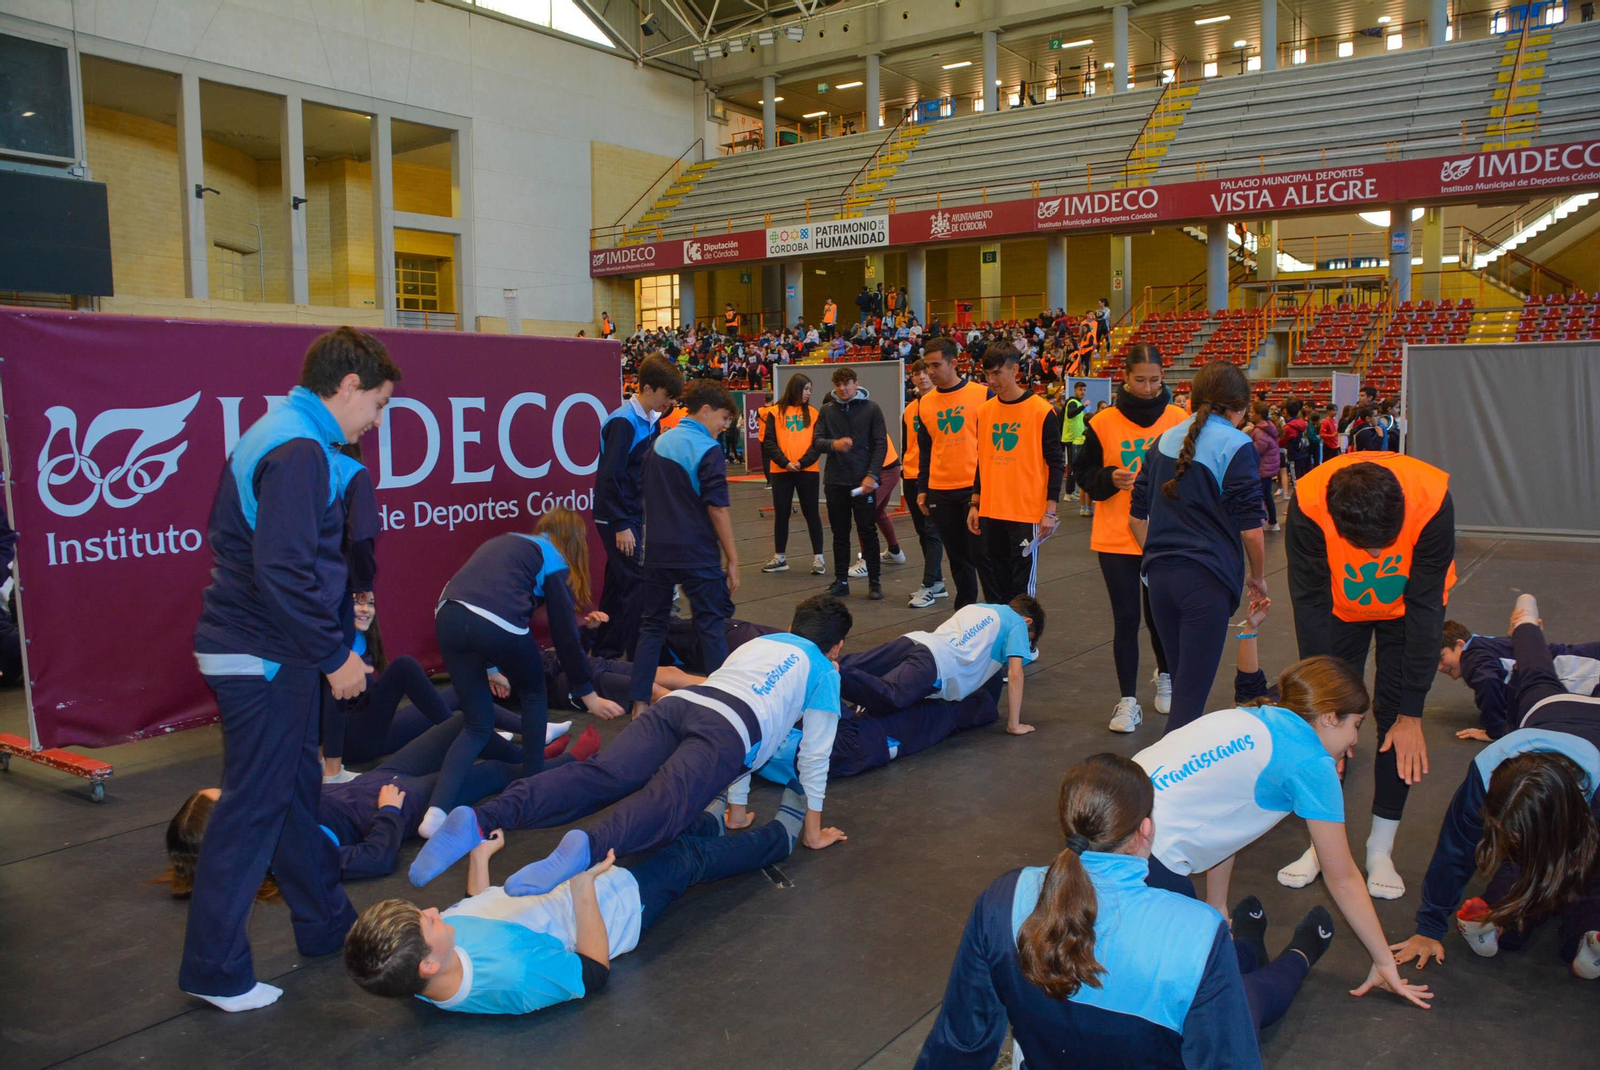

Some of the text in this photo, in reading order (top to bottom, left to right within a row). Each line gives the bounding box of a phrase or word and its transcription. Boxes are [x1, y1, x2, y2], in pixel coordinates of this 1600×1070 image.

[1478, 142, 1600, 178] IMDECO
[1220, 168, 1364, 190] PALACIO MUNICIPAL DEPORTES
[1441, 184, 1473, 193] Instituto
[1475, 180, 1515, 190] Municipal
[1530, 176, 1570, 186] Deportes
[1064, 188, 1158, 216] IMDECO
[1210, 178, 1378, 212] VISTA ALEGRE
[952, 210, 993, 222] AYUNTAMIENTO
[1038, 220, 1061, 228] Instituto
[1063, 217, 1091, 227] Municipal
[1102, 215, 1129, 224] Deportes
[1130, 212, 1157, 220] Córdoba
[816, 220, 876, 237] PATRIMONIO
[952, 220, 987, 232] DE CÓRDOBA
[704, 240, 738, 251] Diputación
[770, 242, 808, 254] CÓRDOBA
[816, 232, 885, 249] HUMANIDAD
[606, 246, 655, 264] IMDECO
[713, 249, 739, 258] Córdoba
[216, 391, 600, 490] IDECO
[414, 497, 519, 531] Deportes
[527, 487, 595, 516] Córdo
[46, 524, 202, 566] Instituto
[752, 654, 800, 696] Franciscanos
[1149, 734, 1254, 791] Franciscanos
